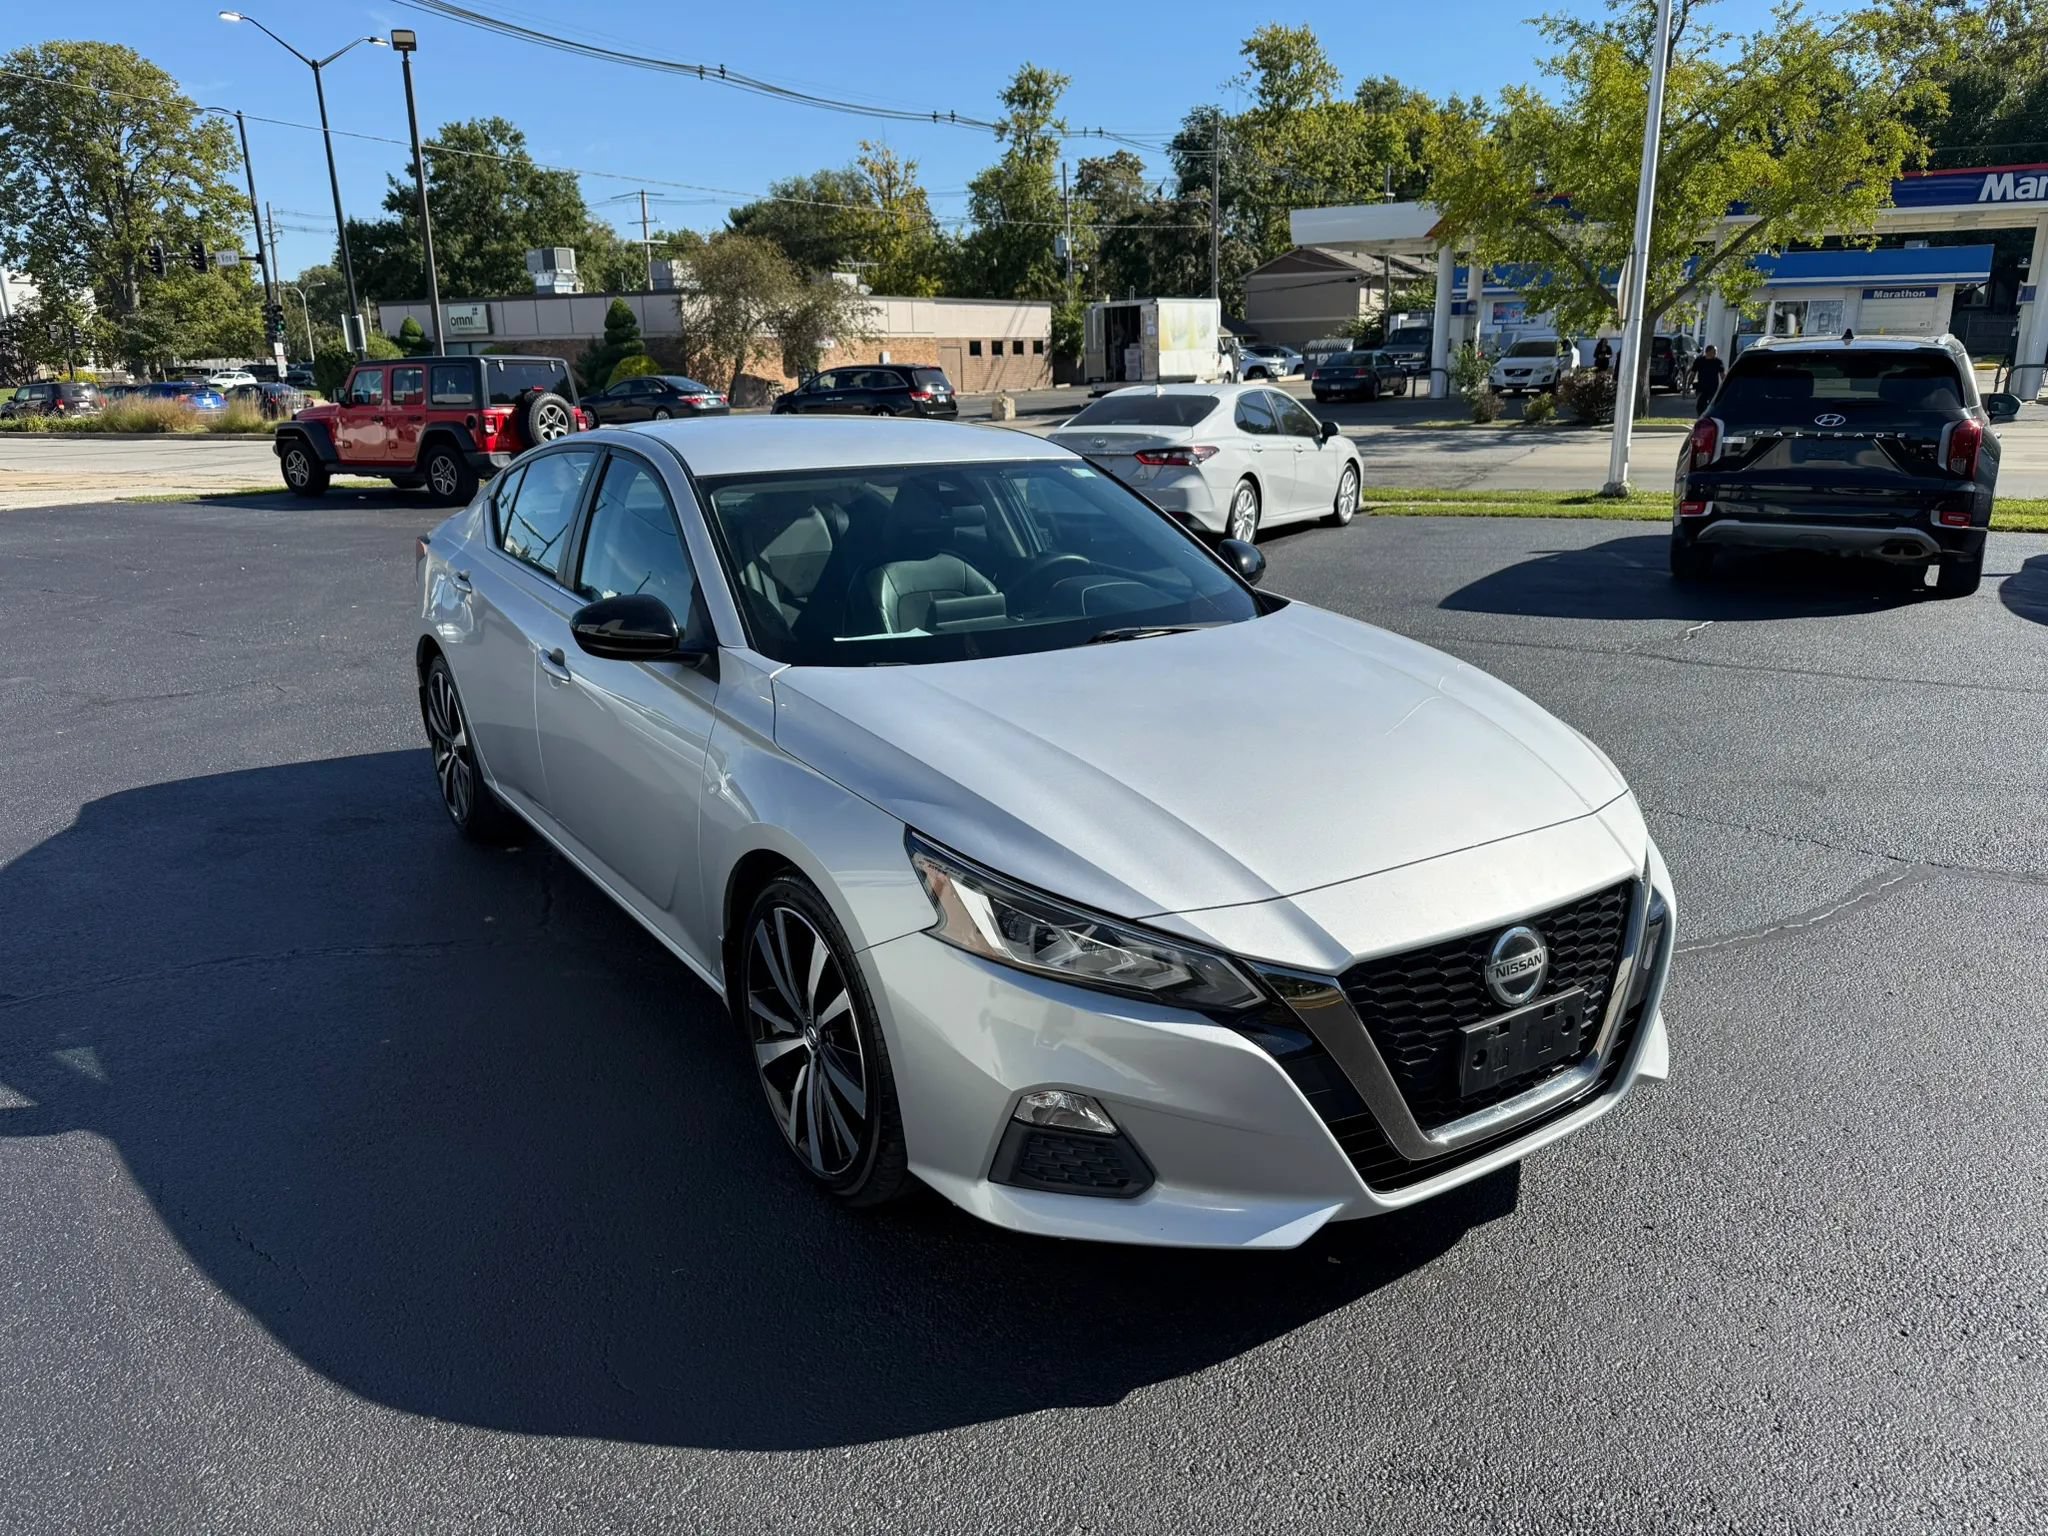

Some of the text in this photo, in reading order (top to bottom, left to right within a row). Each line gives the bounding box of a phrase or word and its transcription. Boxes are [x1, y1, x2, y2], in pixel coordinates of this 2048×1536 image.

[1978, 172, 2048, 202] Mar
[1873, 289, 1926, 299] Marathon
[450, 316, 473, 327] omni
[1754, 430, 1907, 439] PALISADE
[1495, 953, 1542, 979] NISSAN
